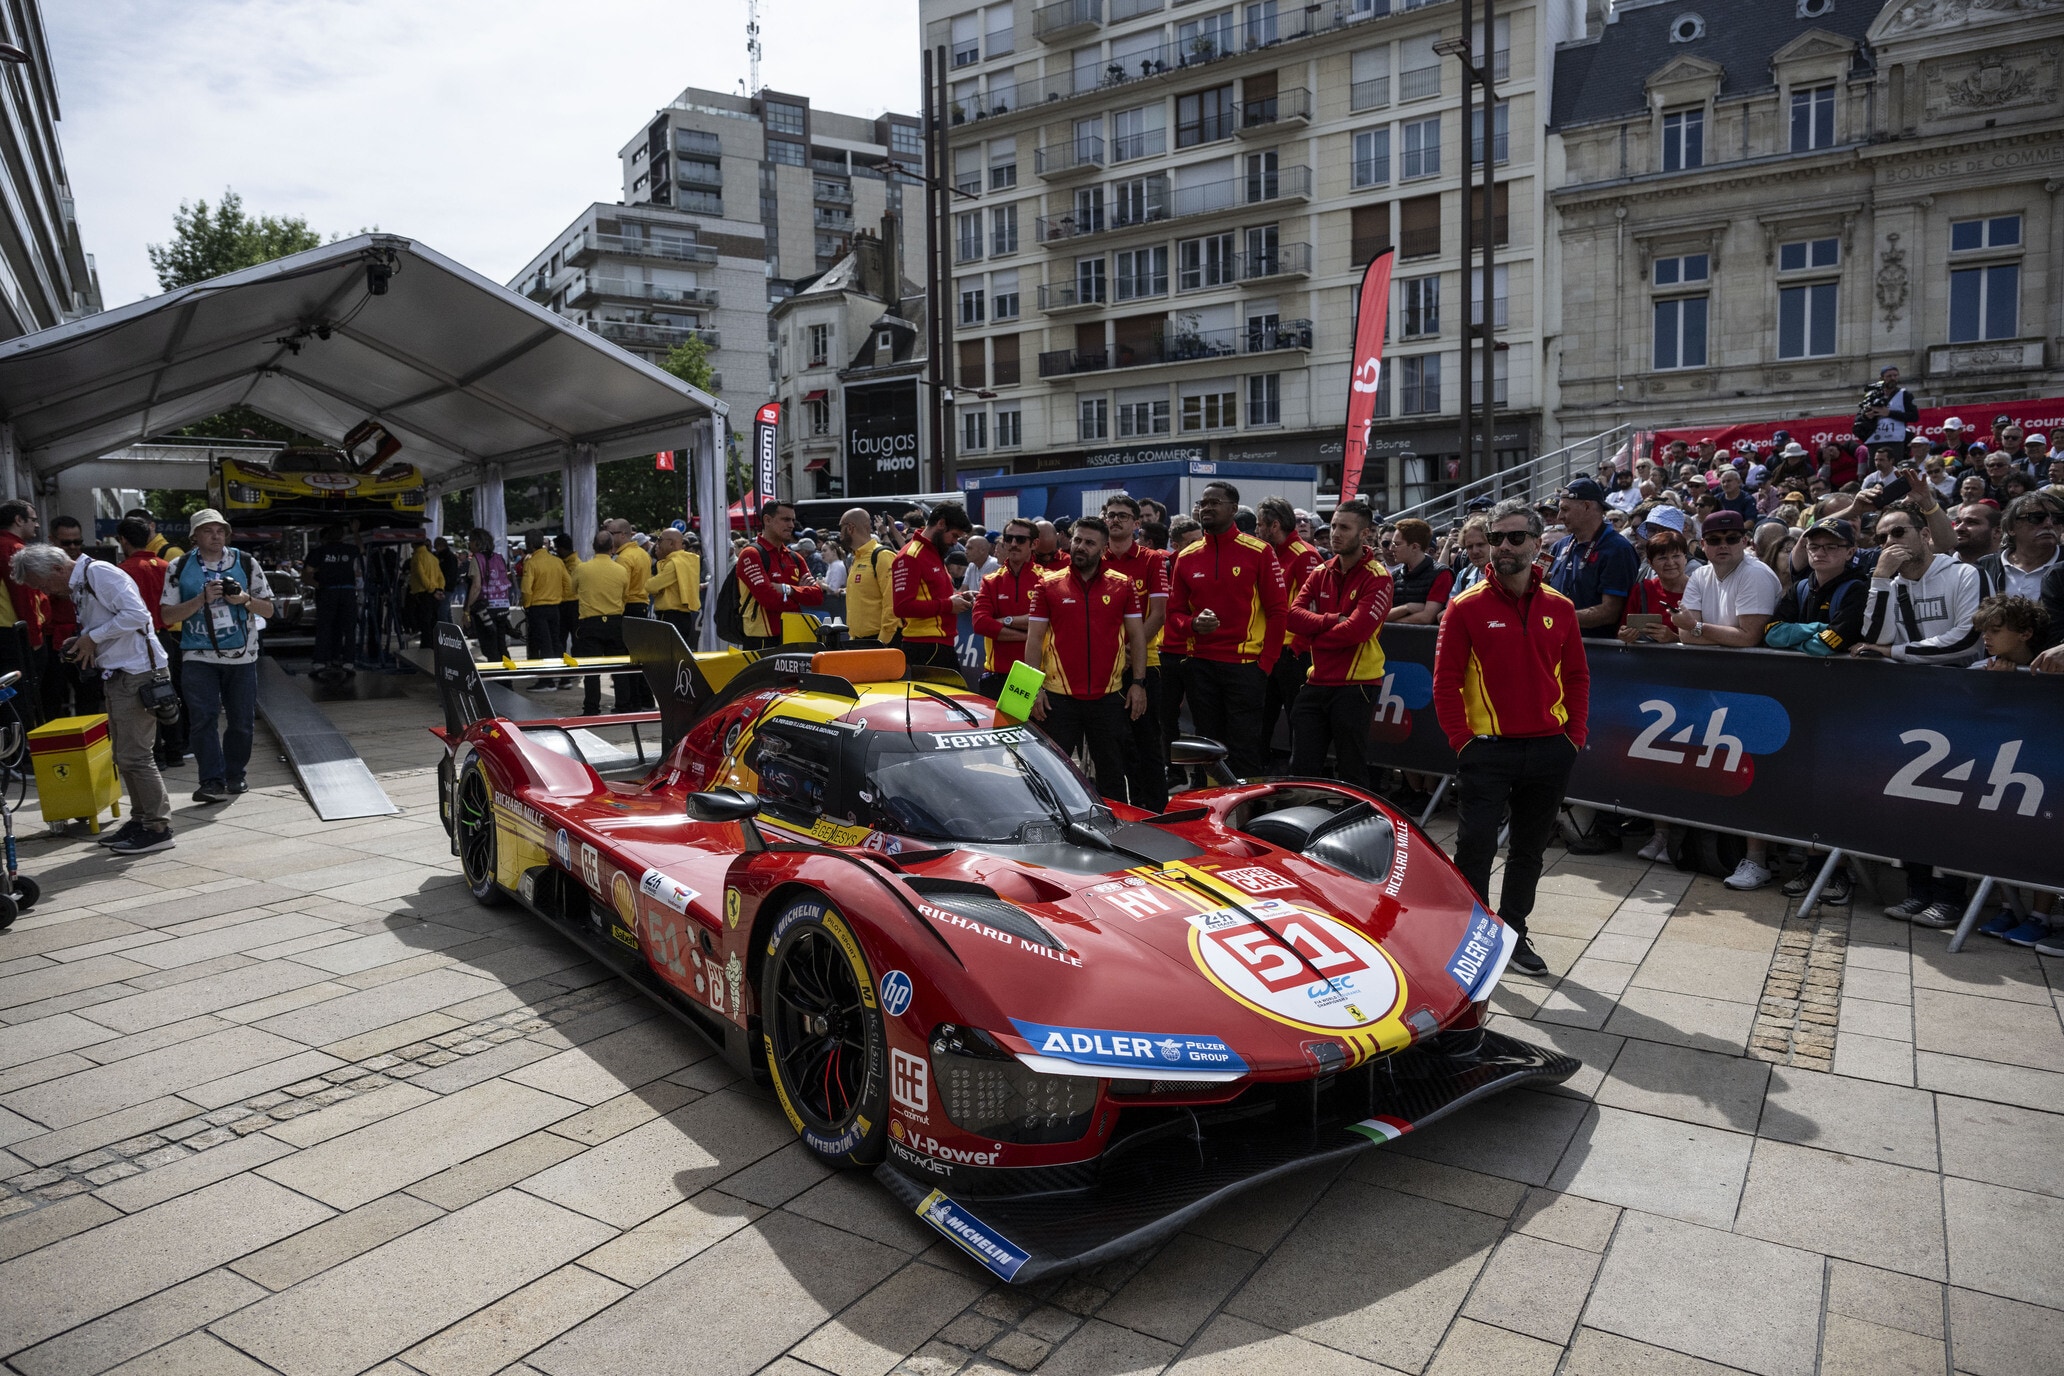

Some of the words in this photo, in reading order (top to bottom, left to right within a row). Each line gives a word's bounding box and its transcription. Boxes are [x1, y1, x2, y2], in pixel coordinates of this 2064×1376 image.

[1886, 161, 1960, 182] BOURSE
[1966, 160, 1985, 172] DE
[1991, 146, 2064, 168] COMME
[852, 429, 915, 457] faugas
[1320, 443, 1342, 454] Café
[1376, 439, 1411, 450] Bourse
[763, 428, 773, 494] FACOM
[877, 456, 915, 472] PHOTO
[1086, 453, 1120, 466] PASSAGE
[1123, 452, 1134, 464] du
[1137, 448, 1202, 463] COMMERCE
[443, 633, 463, 650] Santander
[774, 659, 799, 673] ADLER
[1008, 683, 1032, 700] SAFE
[929, 725, 1038, 750] Ferrari
[1627, 699, 1745, 773] 24h
[1883, 728, 2045, 817] 24h
[494, 791, 523, 817] RICHARD
[523, 807, 546, 829] MILLE
[818, 825, 858, 846] GENESYS
[1385, 849, 1409, 897] RICHARD
[1397, 819, 1409, 850] MILLE
[645, 872, 665, 889] 24h
[1222, 867, 1271, 881] HYPER
[1241, 875, 1294, 891] CAR
[1105, 888, 1171, 918] HY
[778, 904, 820, 934] MICHELIN
[1199, 911, 1237, 926] 24h
[613, 926, 637, 947] Sabelt
[648, 911, 686, 978] 51
[827, 916, 842, 935] PILOT
[842, 933, 857, 960] SPORT
[917, 904, 1012, 945] RICHARD
[1021, 940, 1083, 968] MILLE
[1221, 922, 1356, 982] 51
[1453, 941, 1490, 986] ADLER
[862, 986, 873, 1001] M
[883, 971, 911, 1015] hp
[1307, 975, 1354, 999] WEC
[1041, 1032, 1155, 1058] ADLER
[1186, 1041, 1226, 1052] PELZER
[1189, 1052, 1229, 1062] GROUP
[903, 1108, 930, 1126] azimut
[807, 1132, 855, 1155] MICHELIN
[908, 1130, 999, 1166] V-Power
[889, 1140, 953, 1177] VISTAJET
[945, 1216, 1013, 1265] MICHELIN
